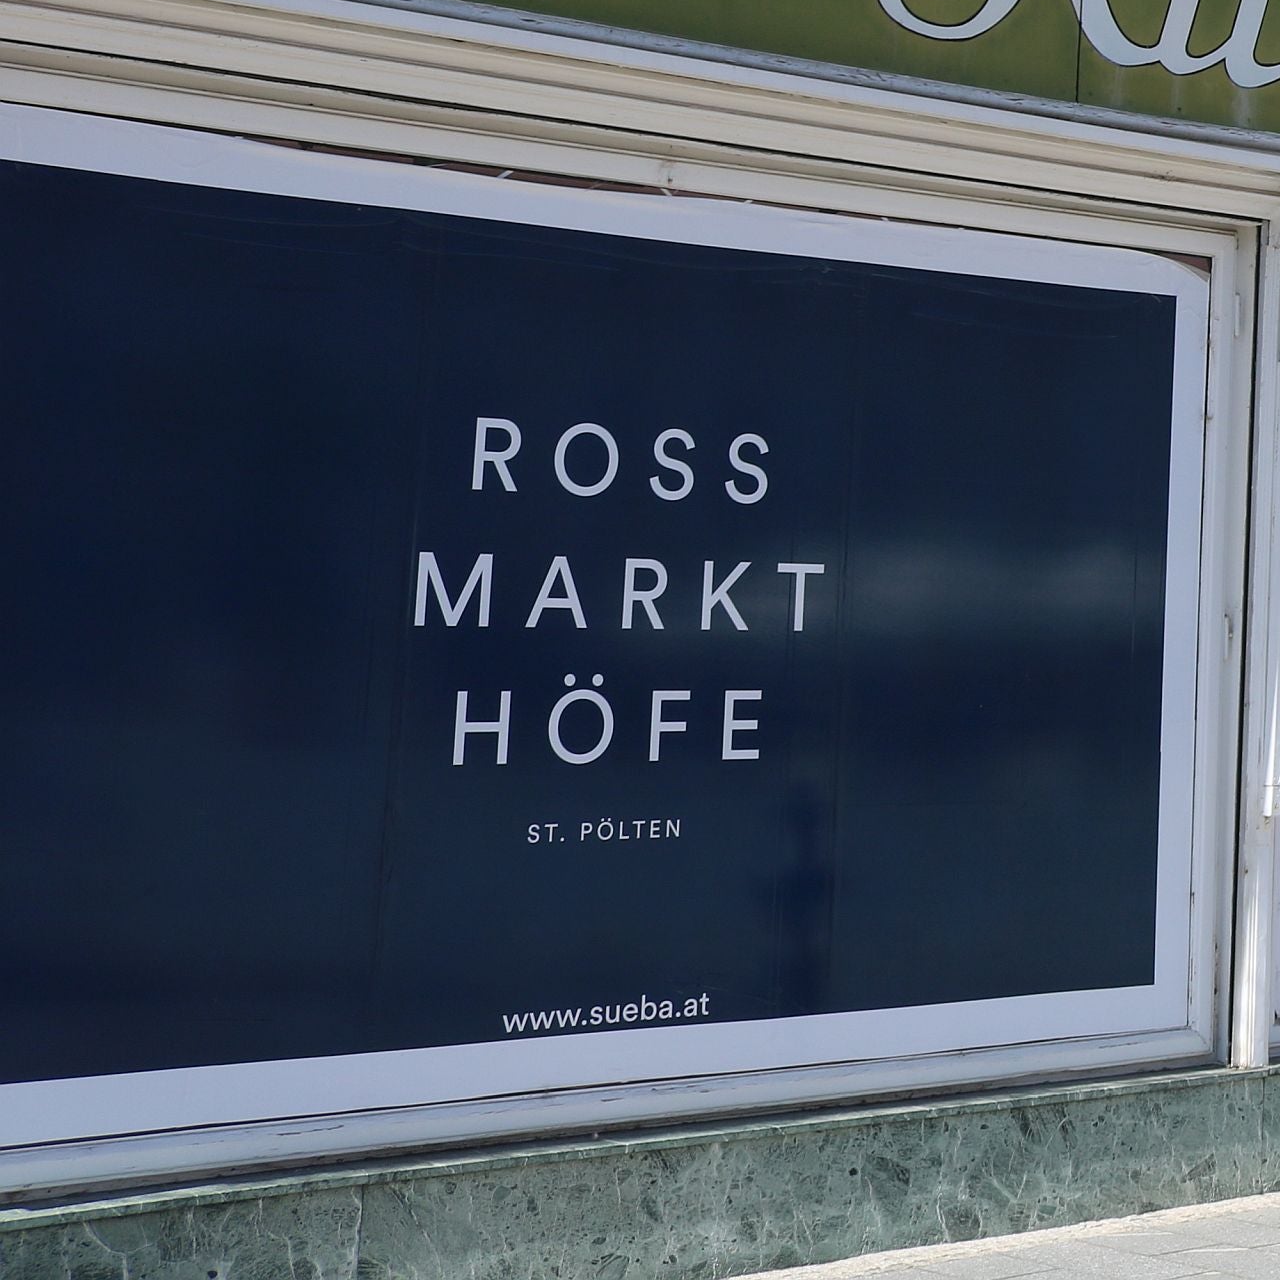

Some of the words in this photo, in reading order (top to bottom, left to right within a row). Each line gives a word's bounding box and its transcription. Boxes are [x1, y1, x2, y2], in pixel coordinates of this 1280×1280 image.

[472, 417, 769, 505] ROSS
[414, 551, 825, 632] MARKT
[453, 674, 763, 766] HÖFE
[527, 823, 565, 844] ST.
[580, 818, 681, 841] PÖLTEN
[502, 992, 710, 1034] www.sueba.at
